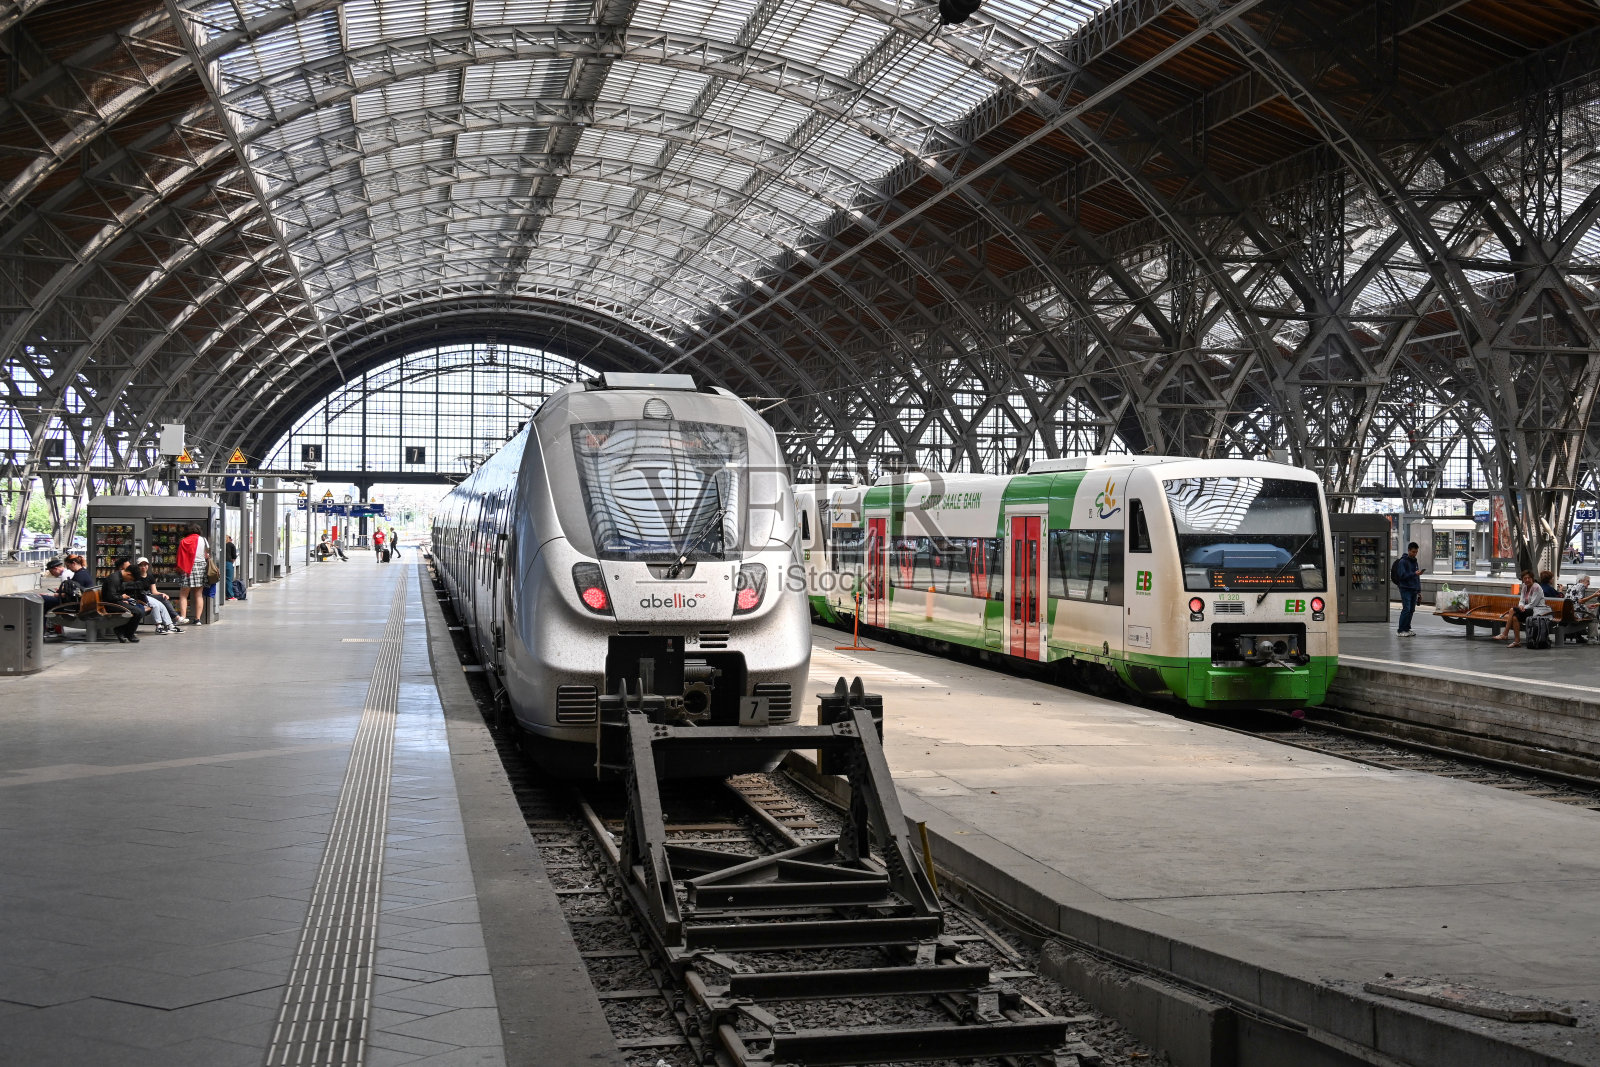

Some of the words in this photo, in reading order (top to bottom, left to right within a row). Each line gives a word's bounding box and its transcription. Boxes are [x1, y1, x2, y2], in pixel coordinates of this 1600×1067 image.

[308, 446, 315, 460] 6
[412, 448, 418, 462] 7
[232, 469, 246, 487] A
[943, 493, 963, 510] SAALE
[964, 492, 982, 509] BAHN
[1578, 510, 1586, 518] 12
[1005, 518, 1010, 537] 2
[1042, 518, 1047, 537] 2
[1136, 570, 1153, 591] EB
[639, 593, 698, 609] abellio
[1227, 593, 1240, 601] 320
[1284, 599, 1306, 613] EB
[750, 701, 759, 720] 7
